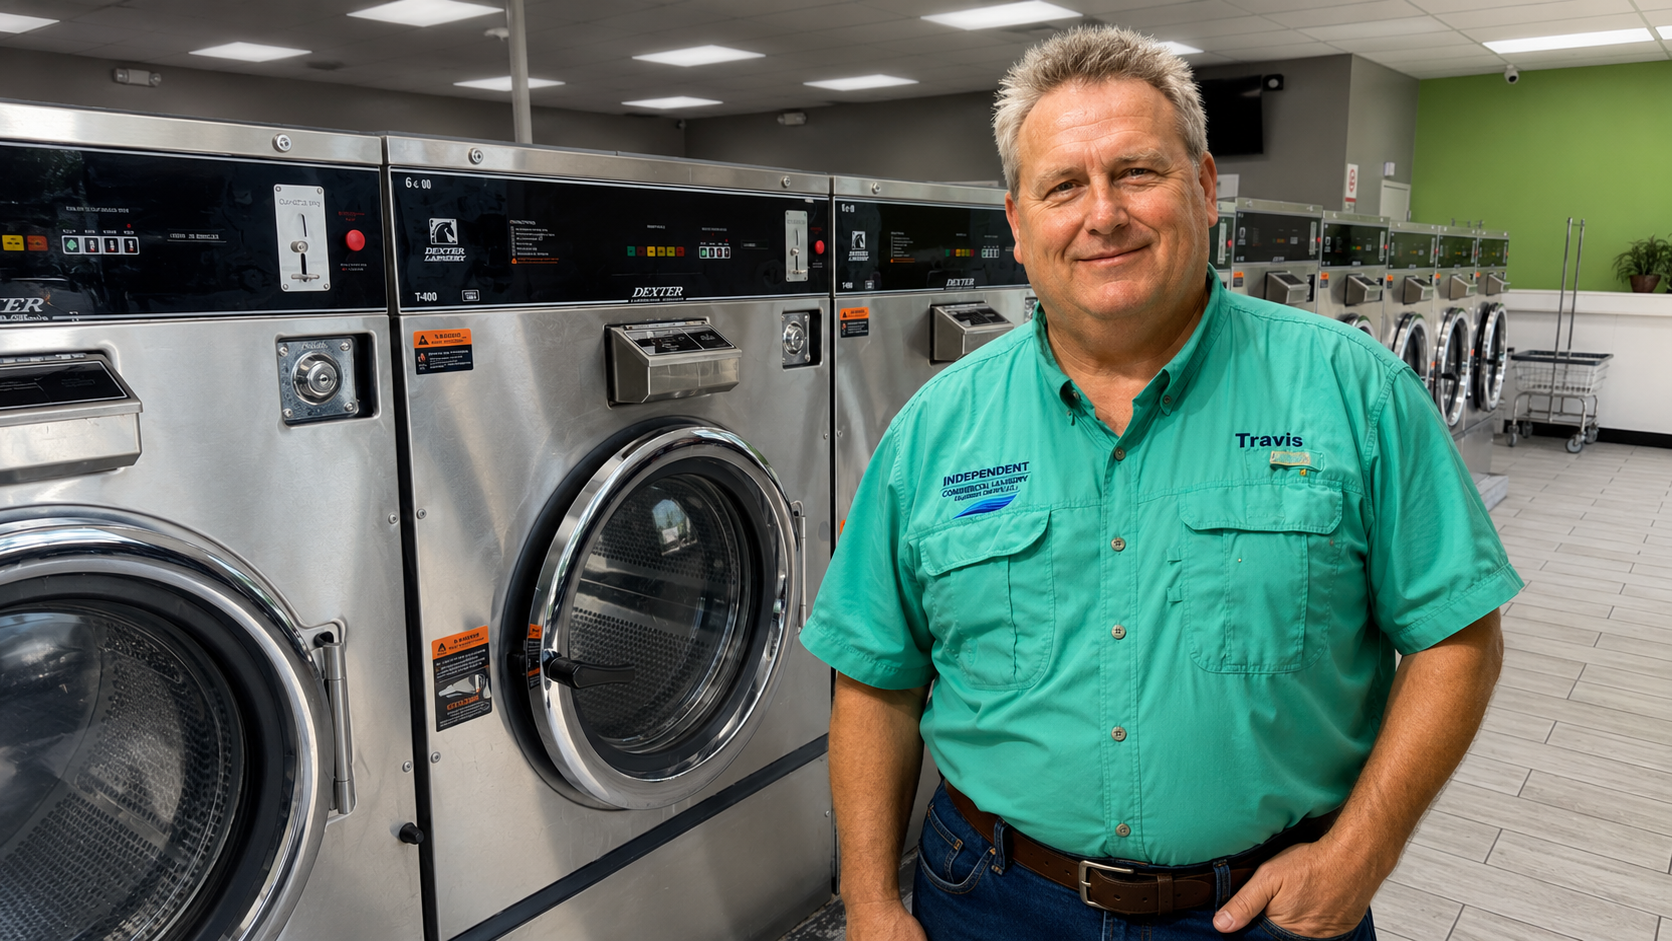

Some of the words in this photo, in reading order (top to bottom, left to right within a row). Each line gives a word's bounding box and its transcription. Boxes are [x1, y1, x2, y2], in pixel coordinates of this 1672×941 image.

[405, 177, 412, 189] 6
[425, 247, 465, 255] DEXTER
[415, 292, 437, 302] T-400
[632, 286, 683, 298] DEXTER
[1235, 432, 1303, 448] Travis
[943, 461, 1029, 486] INDEPENDENT
